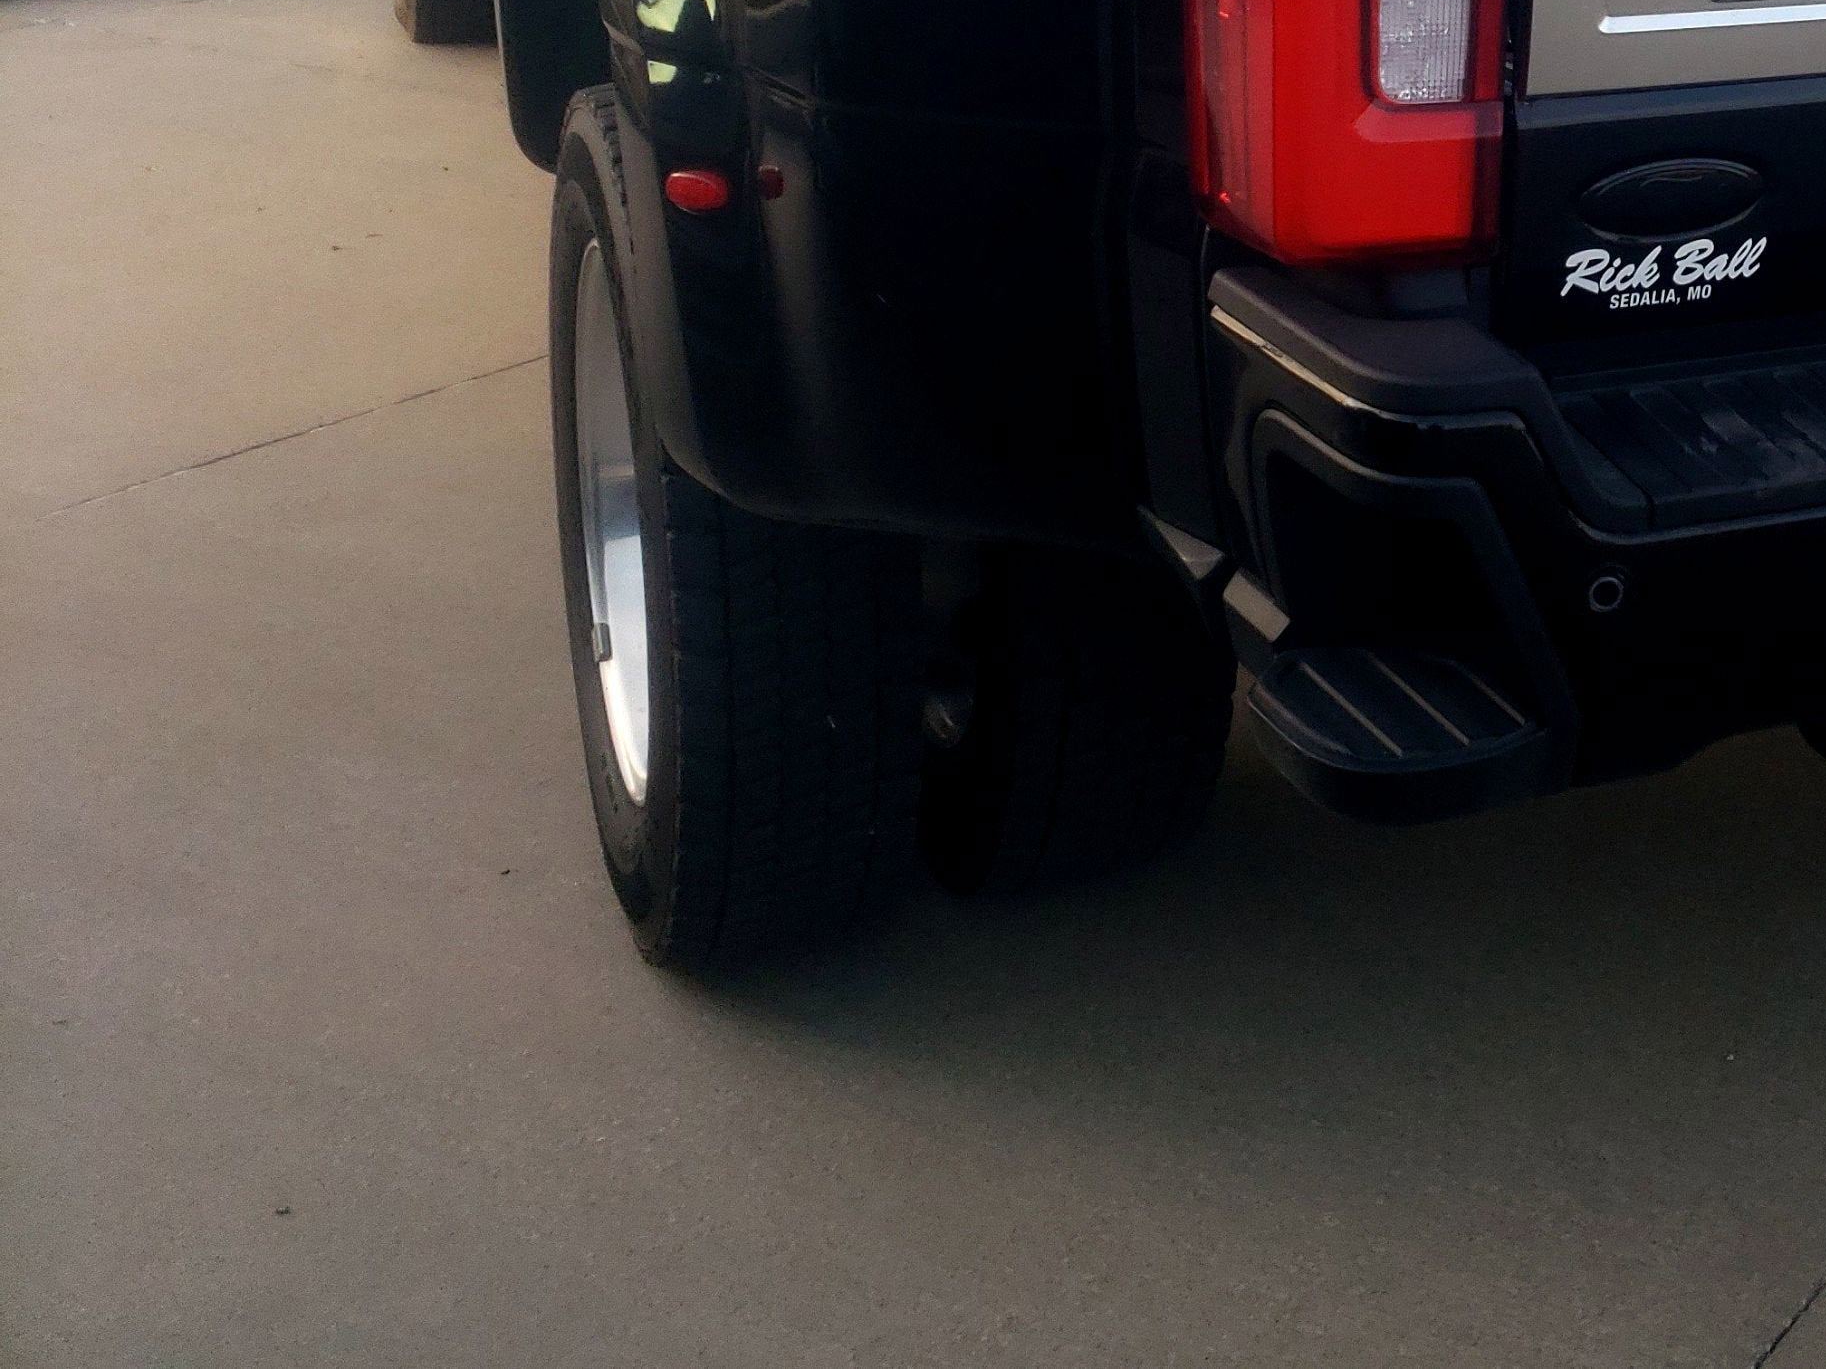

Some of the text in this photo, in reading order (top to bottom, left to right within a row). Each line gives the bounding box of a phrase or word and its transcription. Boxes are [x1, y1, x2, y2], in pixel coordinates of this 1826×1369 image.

[1560, 237, 1767, 297] Rick Ball
[1609, 284, 1712, 310] SEDALIA, MO
